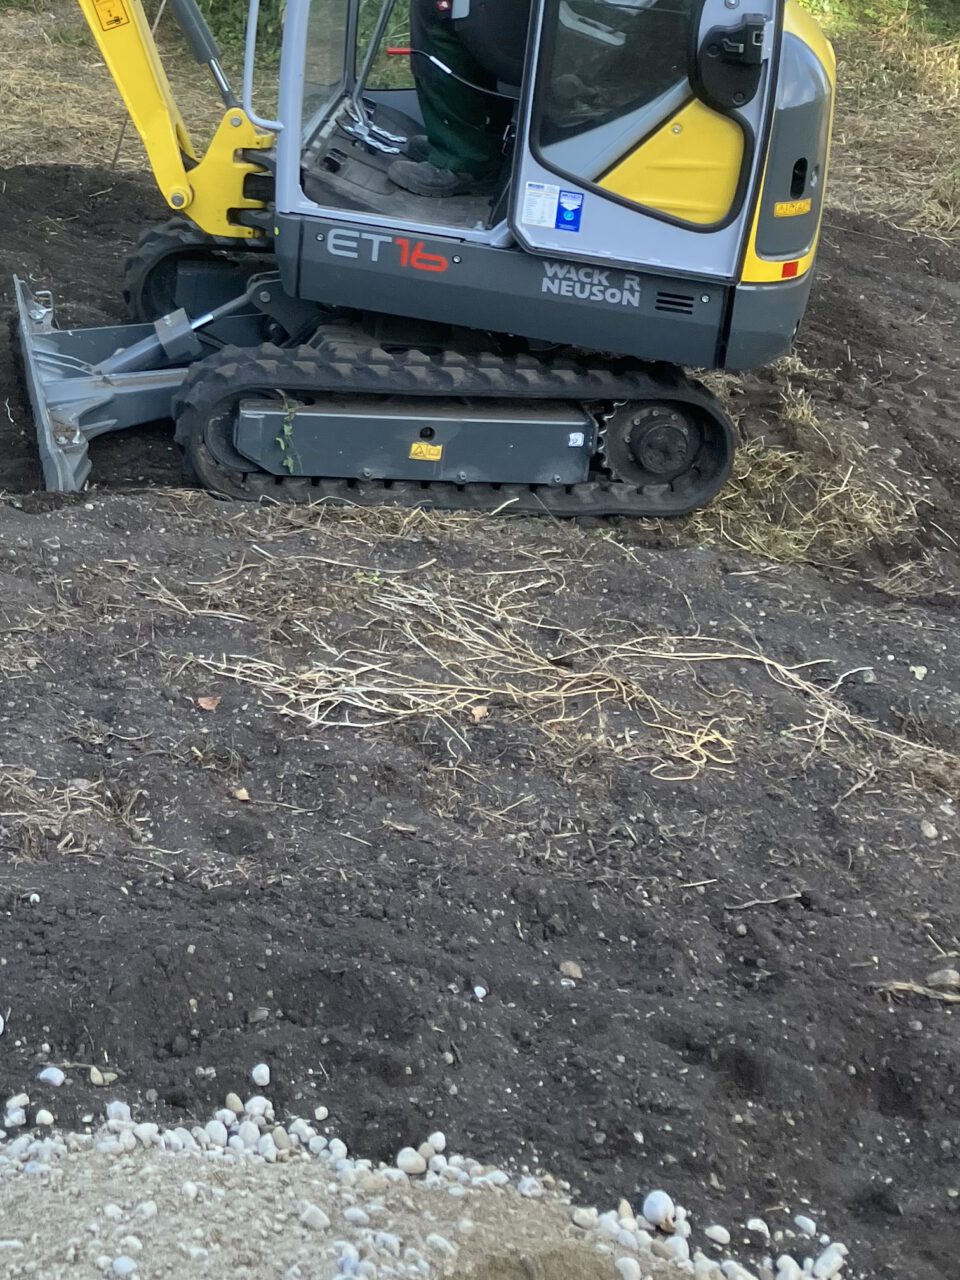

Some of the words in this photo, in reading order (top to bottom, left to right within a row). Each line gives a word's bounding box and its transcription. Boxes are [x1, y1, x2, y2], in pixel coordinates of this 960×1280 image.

[327, 228, 448, 272] ET16
[543, 261, 640, 291] WACKR
[542, 277, 640, 307] NEUSON
